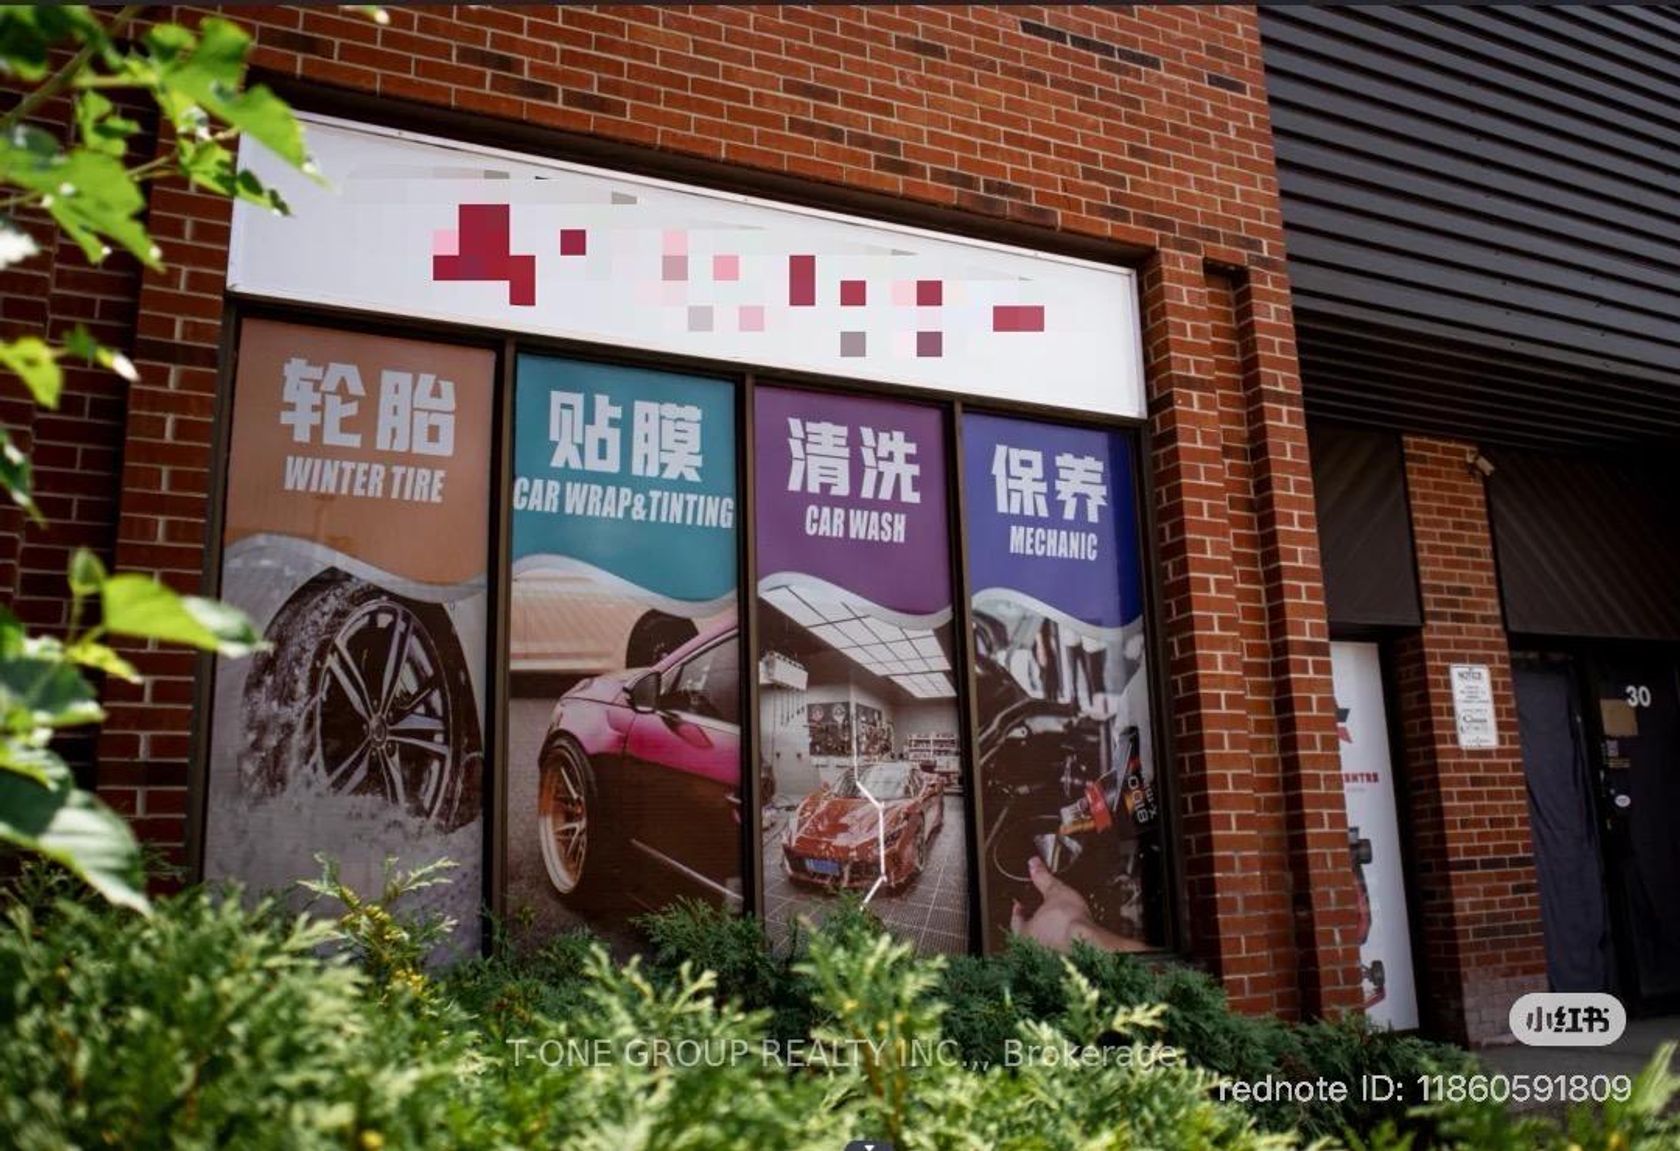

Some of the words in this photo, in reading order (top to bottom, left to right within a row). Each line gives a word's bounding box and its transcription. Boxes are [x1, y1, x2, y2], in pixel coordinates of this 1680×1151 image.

[279, 357, 456, 456] 轮胎
[549, 389, 703, 483] 贴膜
[787, 416, 921, 504] 清洗
[283, 456, 384, 499] WINTER
[388, 464, 447, 503] TIRE
[512, 477, 559, 513] CAR
[564, 482, 735, 529] WRAP&TINTING
[991, 444, 1108, 524] 保养
[805, 505, 844, 538] CAR
[848, 509, 907, 543] WASH
[1009, 525, 1098, 561] MECHANIC
[1626, 685, 1651, 707] 30
